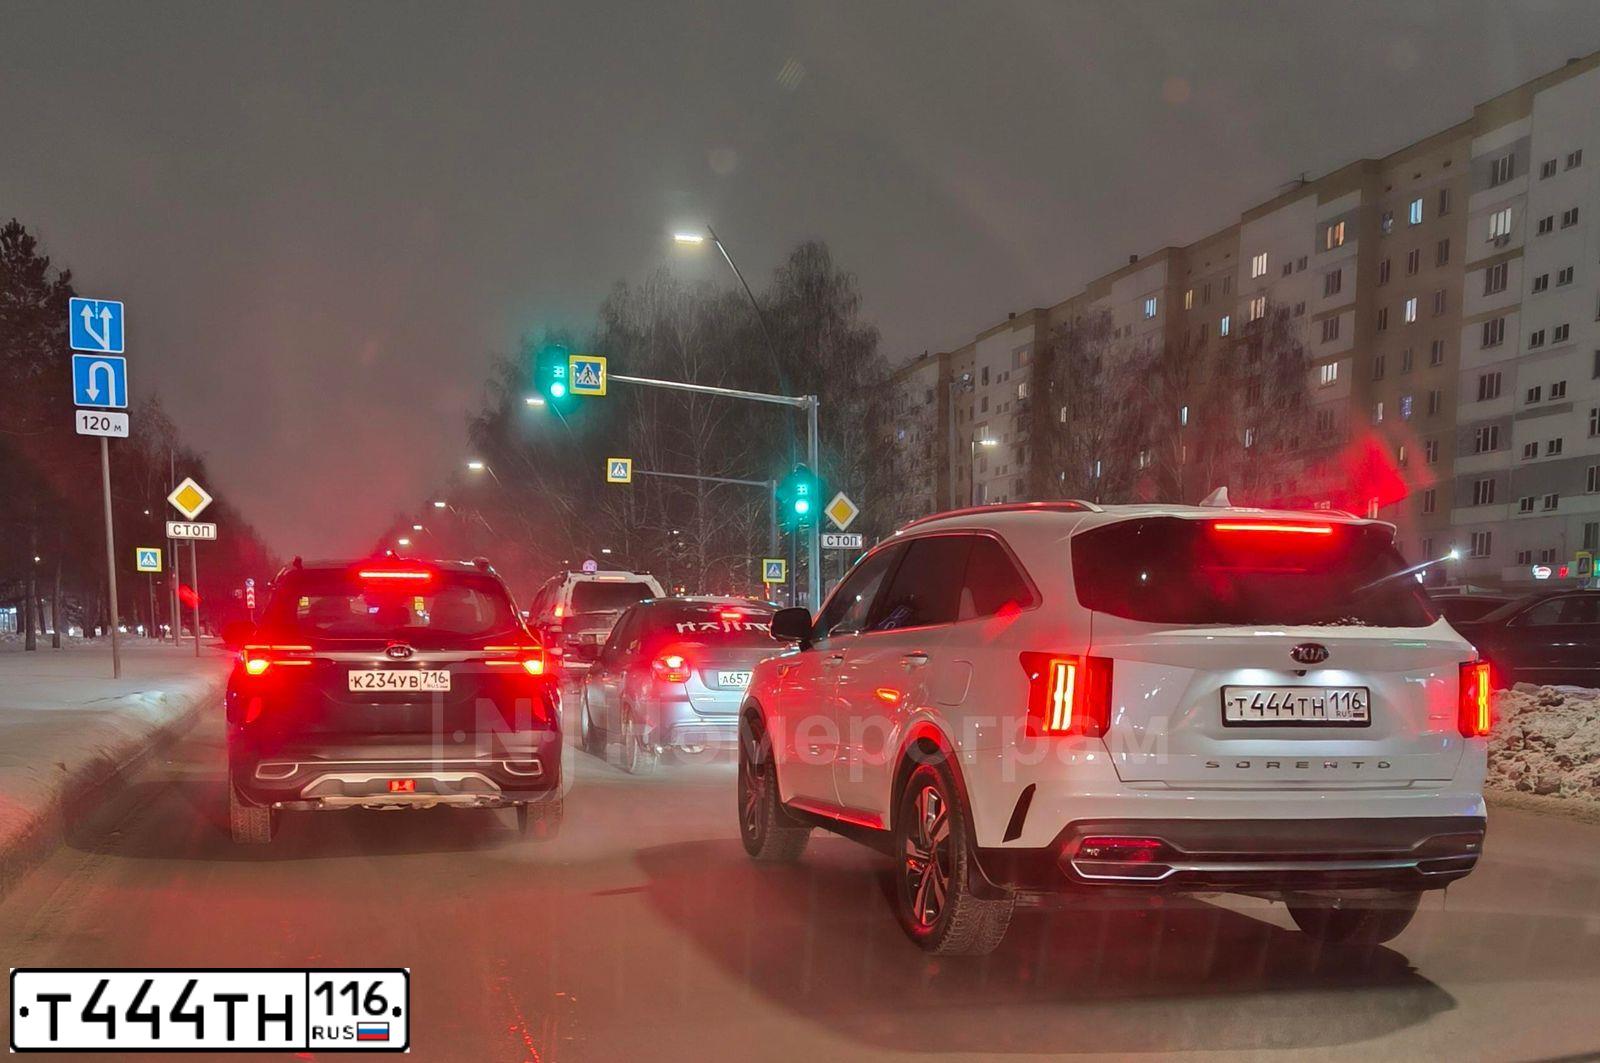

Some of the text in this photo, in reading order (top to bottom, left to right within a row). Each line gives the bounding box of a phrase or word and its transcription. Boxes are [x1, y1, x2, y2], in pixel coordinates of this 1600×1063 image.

[82, 416, 110, 431] 120
[173, 524, 210, 537] СТОП
[827, 535, 858, 546] СТОП
[1298, 648, 1327, 659] KIA
[421, 671, 447, 684] 716
[1329, 692, 1362, 710] 116
[1335, 710, 1353, 718] RUS
[1205, 761, 1391, 769] SORENTO
